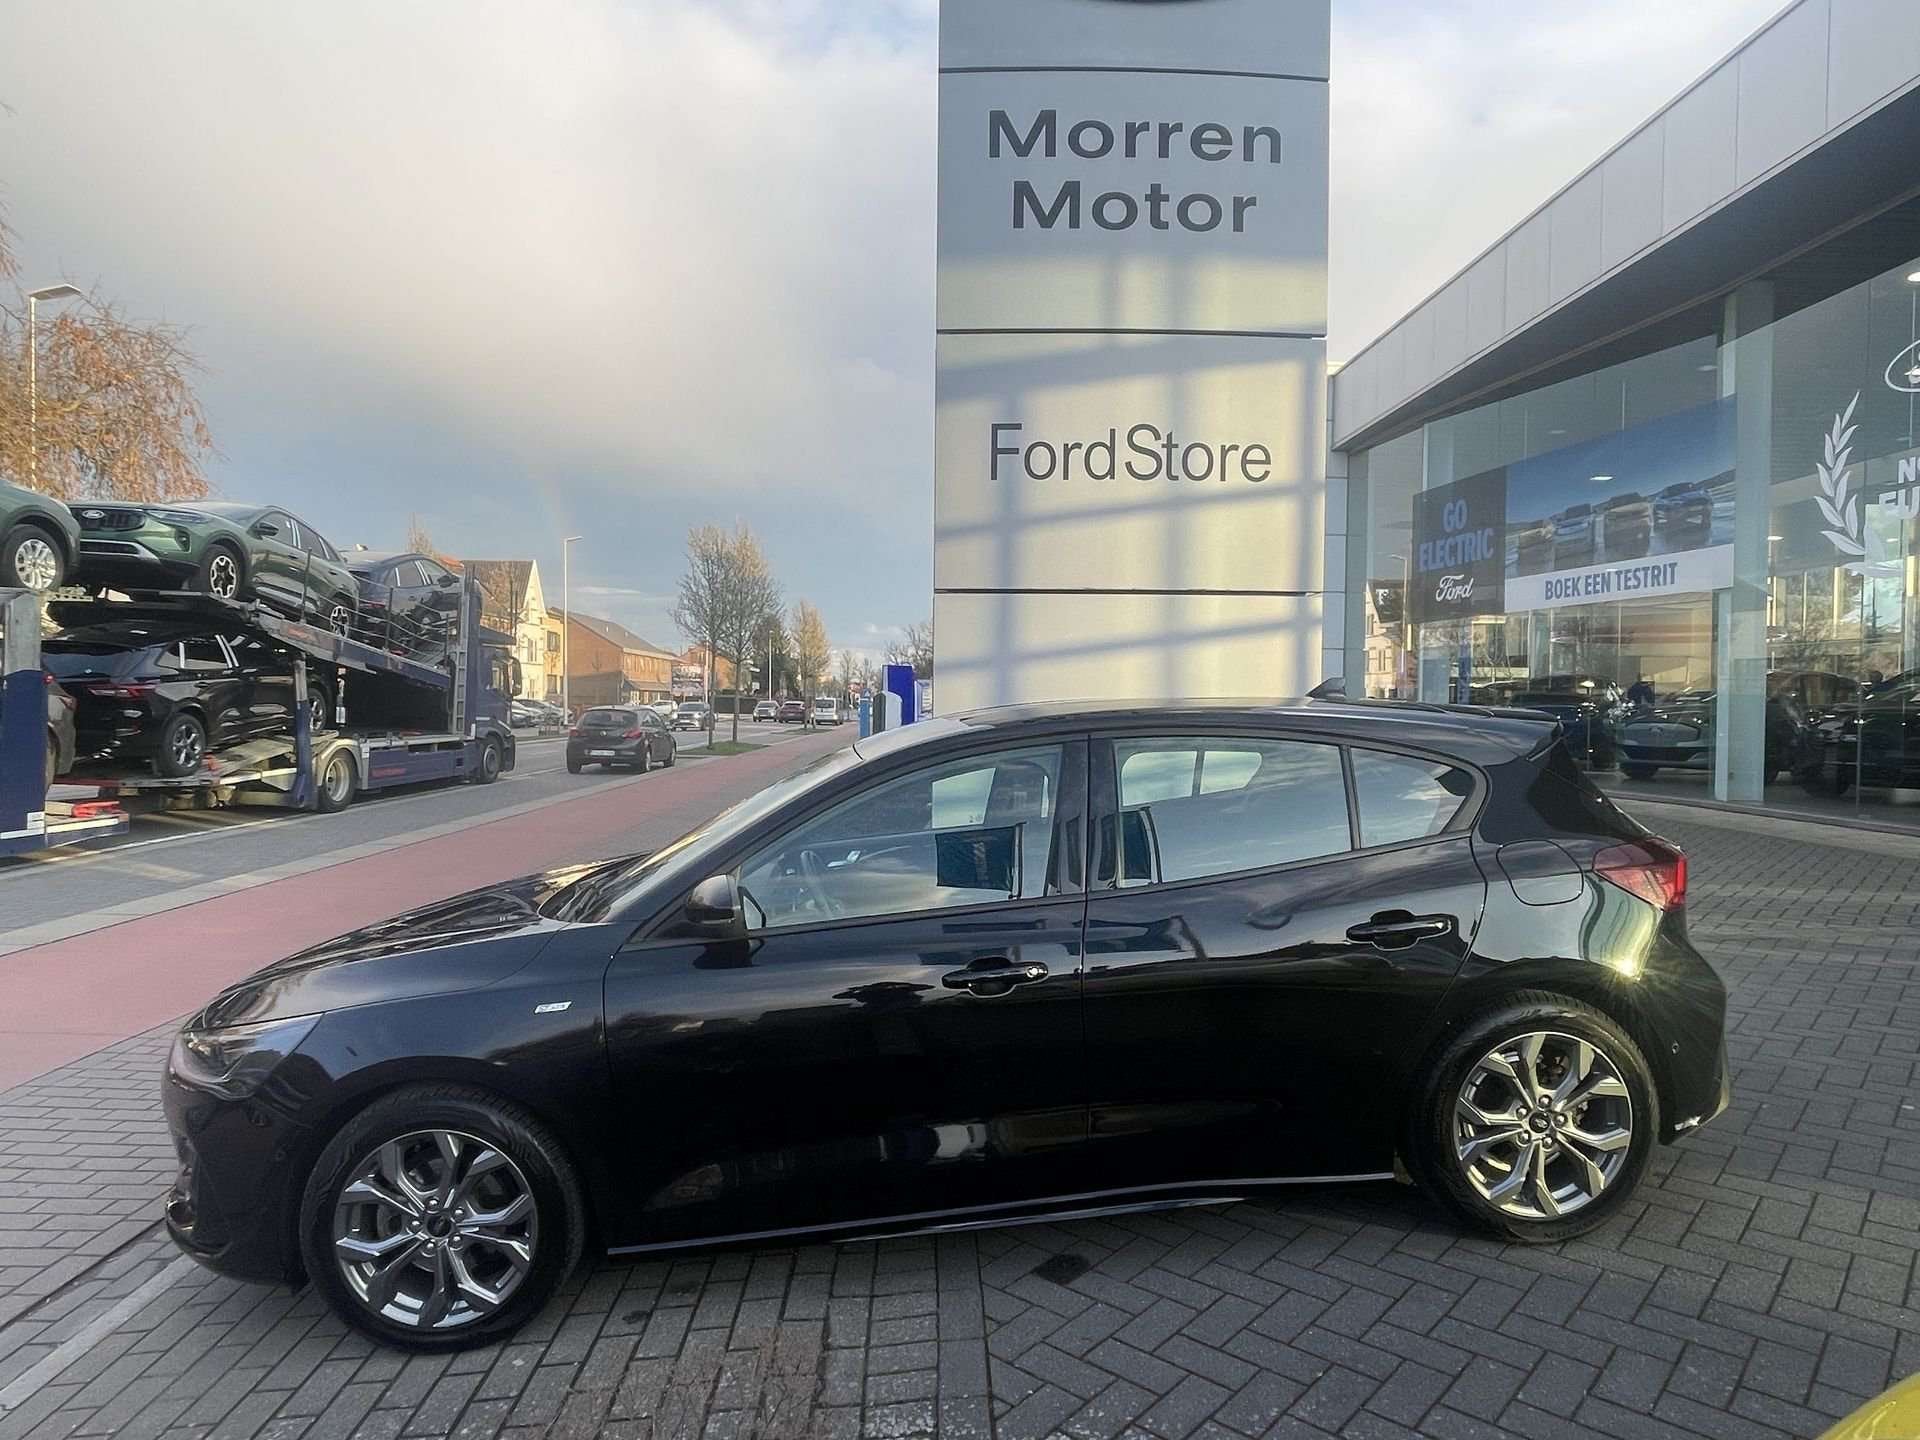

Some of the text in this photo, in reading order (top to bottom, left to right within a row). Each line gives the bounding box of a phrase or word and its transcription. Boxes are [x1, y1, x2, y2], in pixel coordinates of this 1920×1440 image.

[988, 109, 1282, 163] Morren
[1012, 180, 1257, 233] Motor
[990, 422, 1272, 482] FordStore
[1898, 456, 1920, 484] N
[1444, 501, 1468, 529] GO
[1420, 528, 1494, 571] ELECTRIC
[1435, 574, 1474, 602] Ford
[1544, 563, 1678, 600] BOEK EEN TESTRIT
